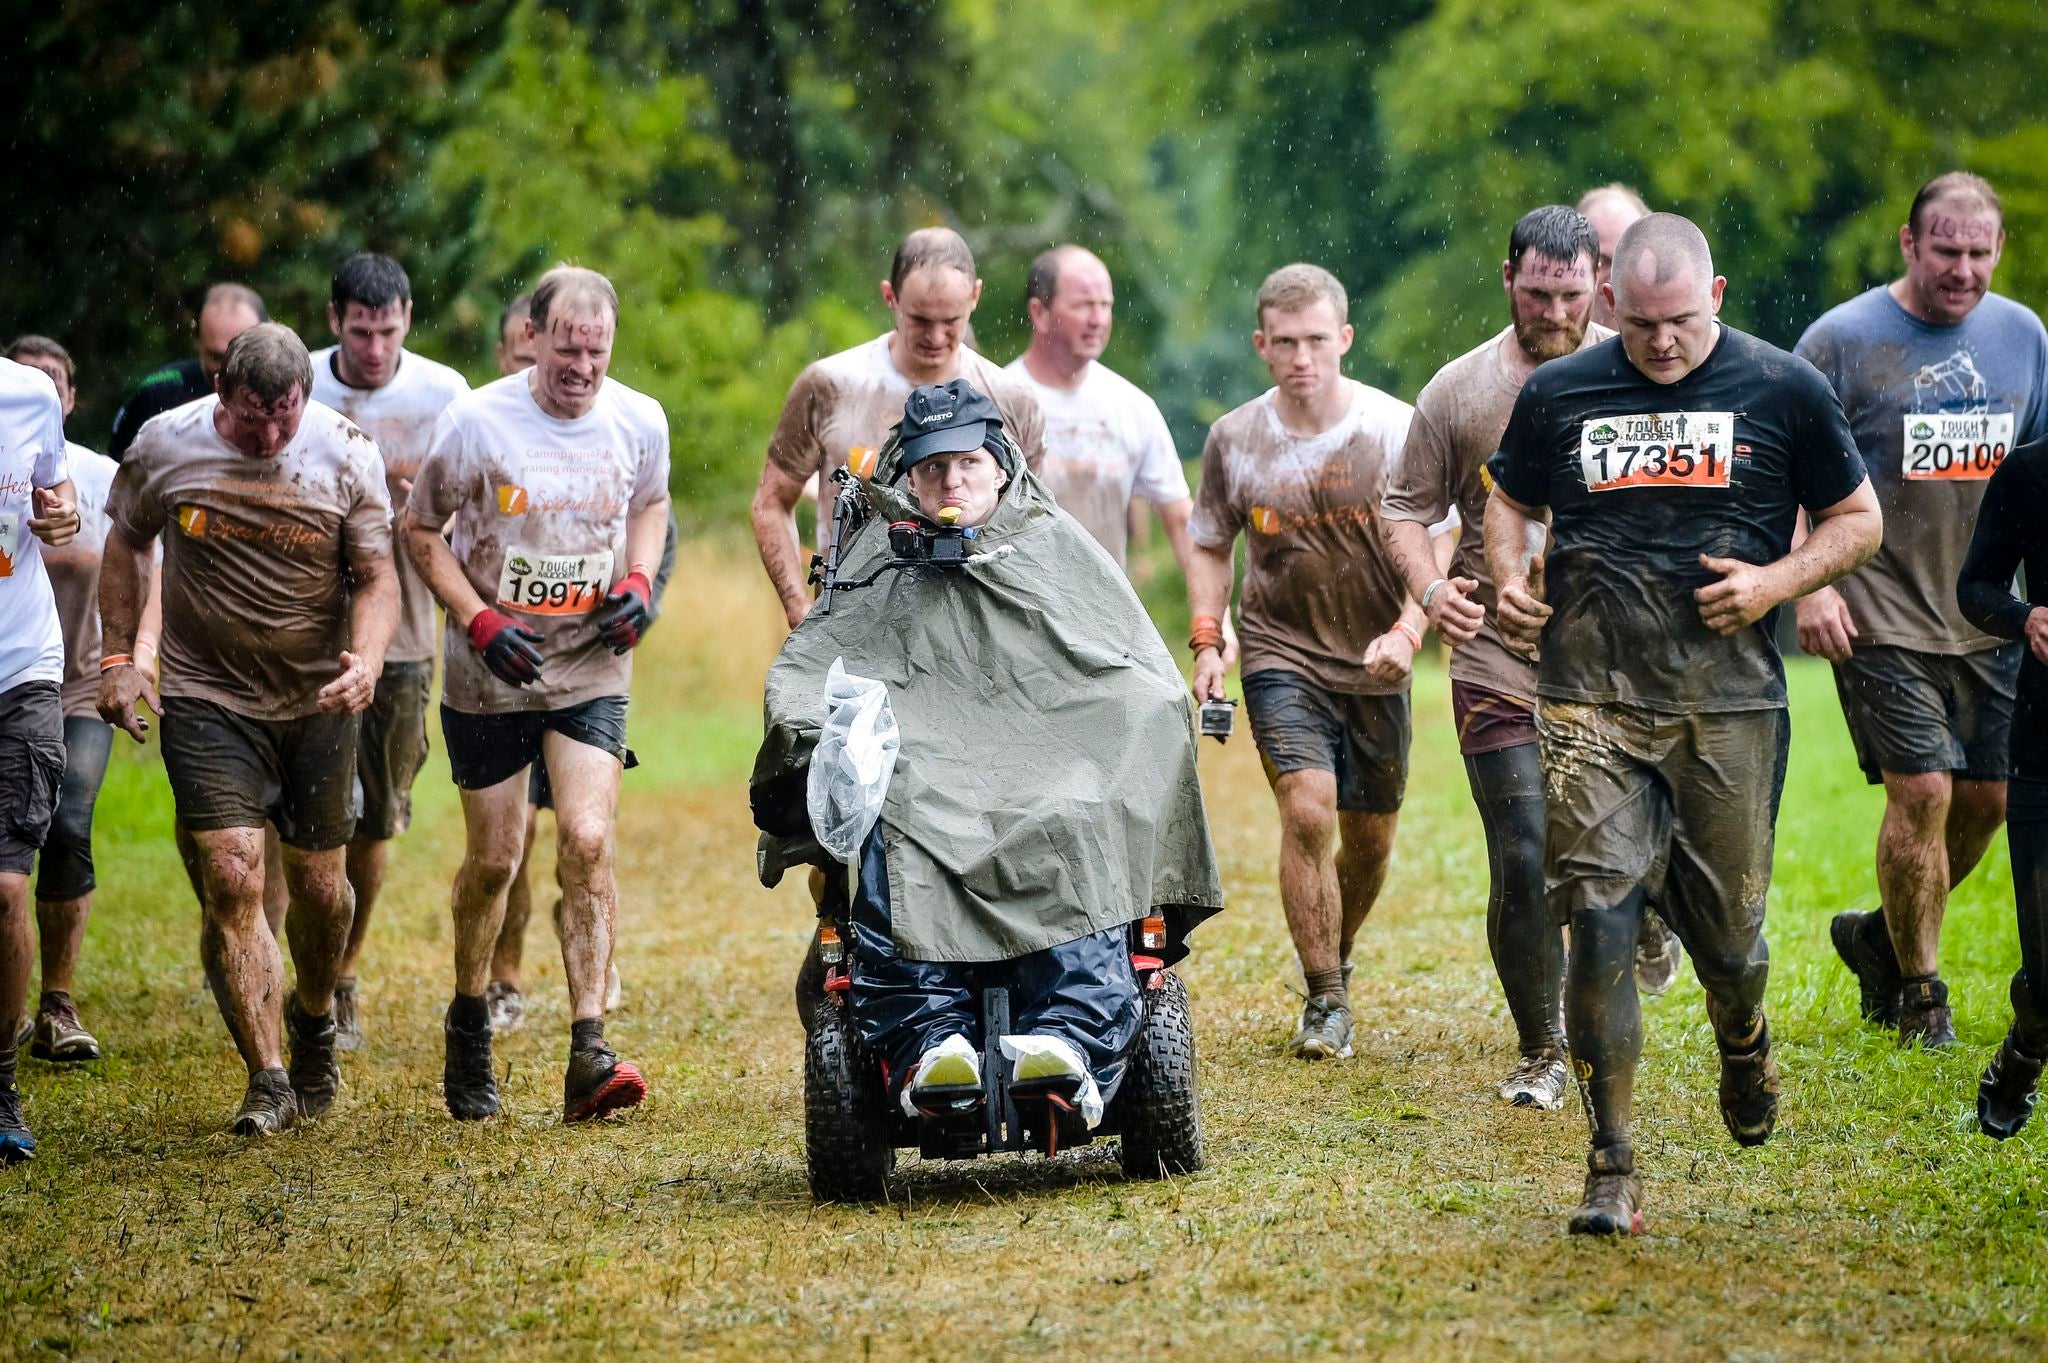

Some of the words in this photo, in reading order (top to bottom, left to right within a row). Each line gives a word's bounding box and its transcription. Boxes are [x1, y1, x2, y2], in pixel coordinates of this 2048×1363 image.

[920, 412, 953, 424] MUSTO
[1626, 420, 1673, 433] TOUGH
[1941, 420, 1978, 432] TOUGH
[1625, 432, 1674, 442] MUDDER
[1592, 443, 1716, 481] 17351
[1911, 443, 2004, 470] 20109
[526, 463, 560, 475] raising
[562, 465, 598, 475] money
[540, 560, 576, 572] TOUGH
[509, 577, 602, 607] 19971
